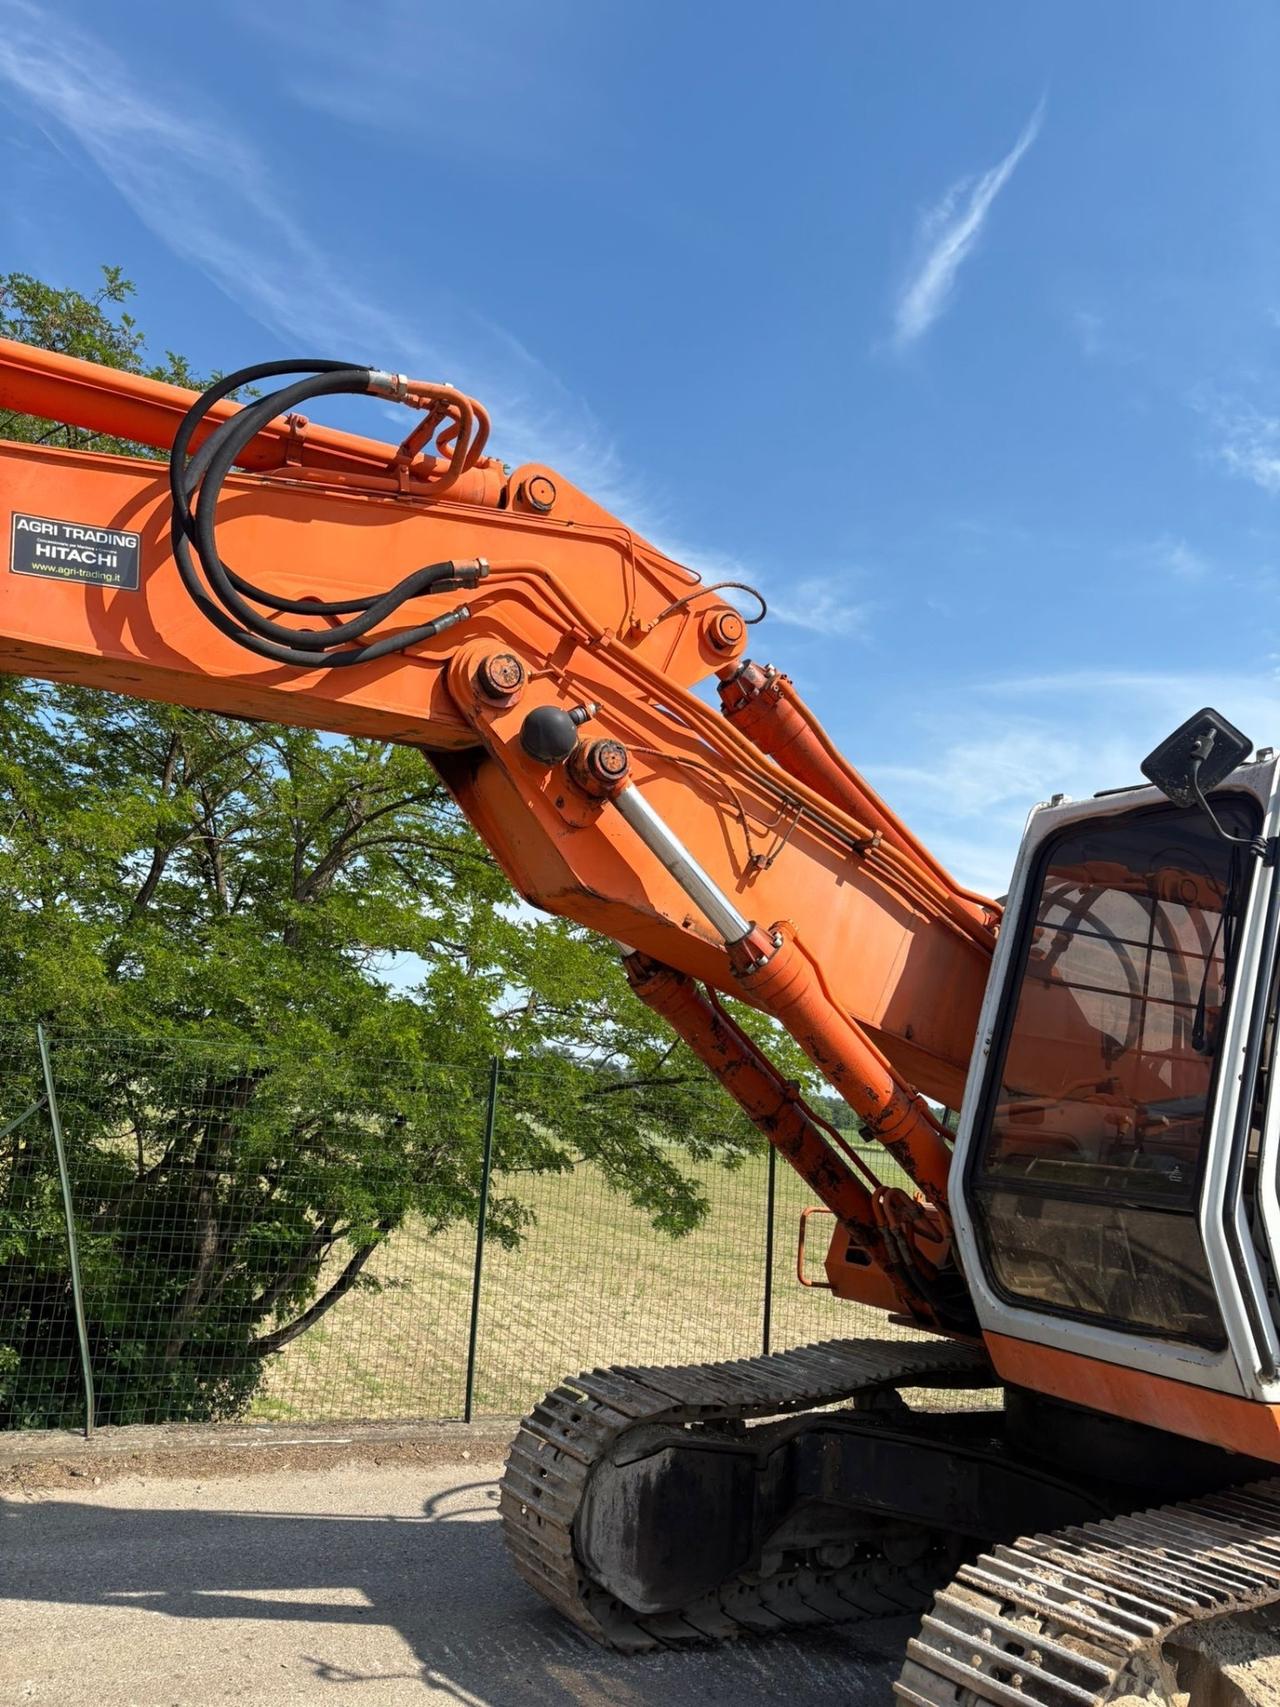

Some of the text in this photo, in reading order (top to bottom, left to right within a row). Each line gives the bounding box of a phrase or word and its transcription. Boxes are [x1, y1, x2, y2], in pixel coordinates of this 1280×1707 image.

[17, 519, 58, 536] AGRI
[62, 526, 137, 549] TRADING
[35, 543, 118, 568] HITACHI
[31, 562, 121, 582] www.agri-trading.it
